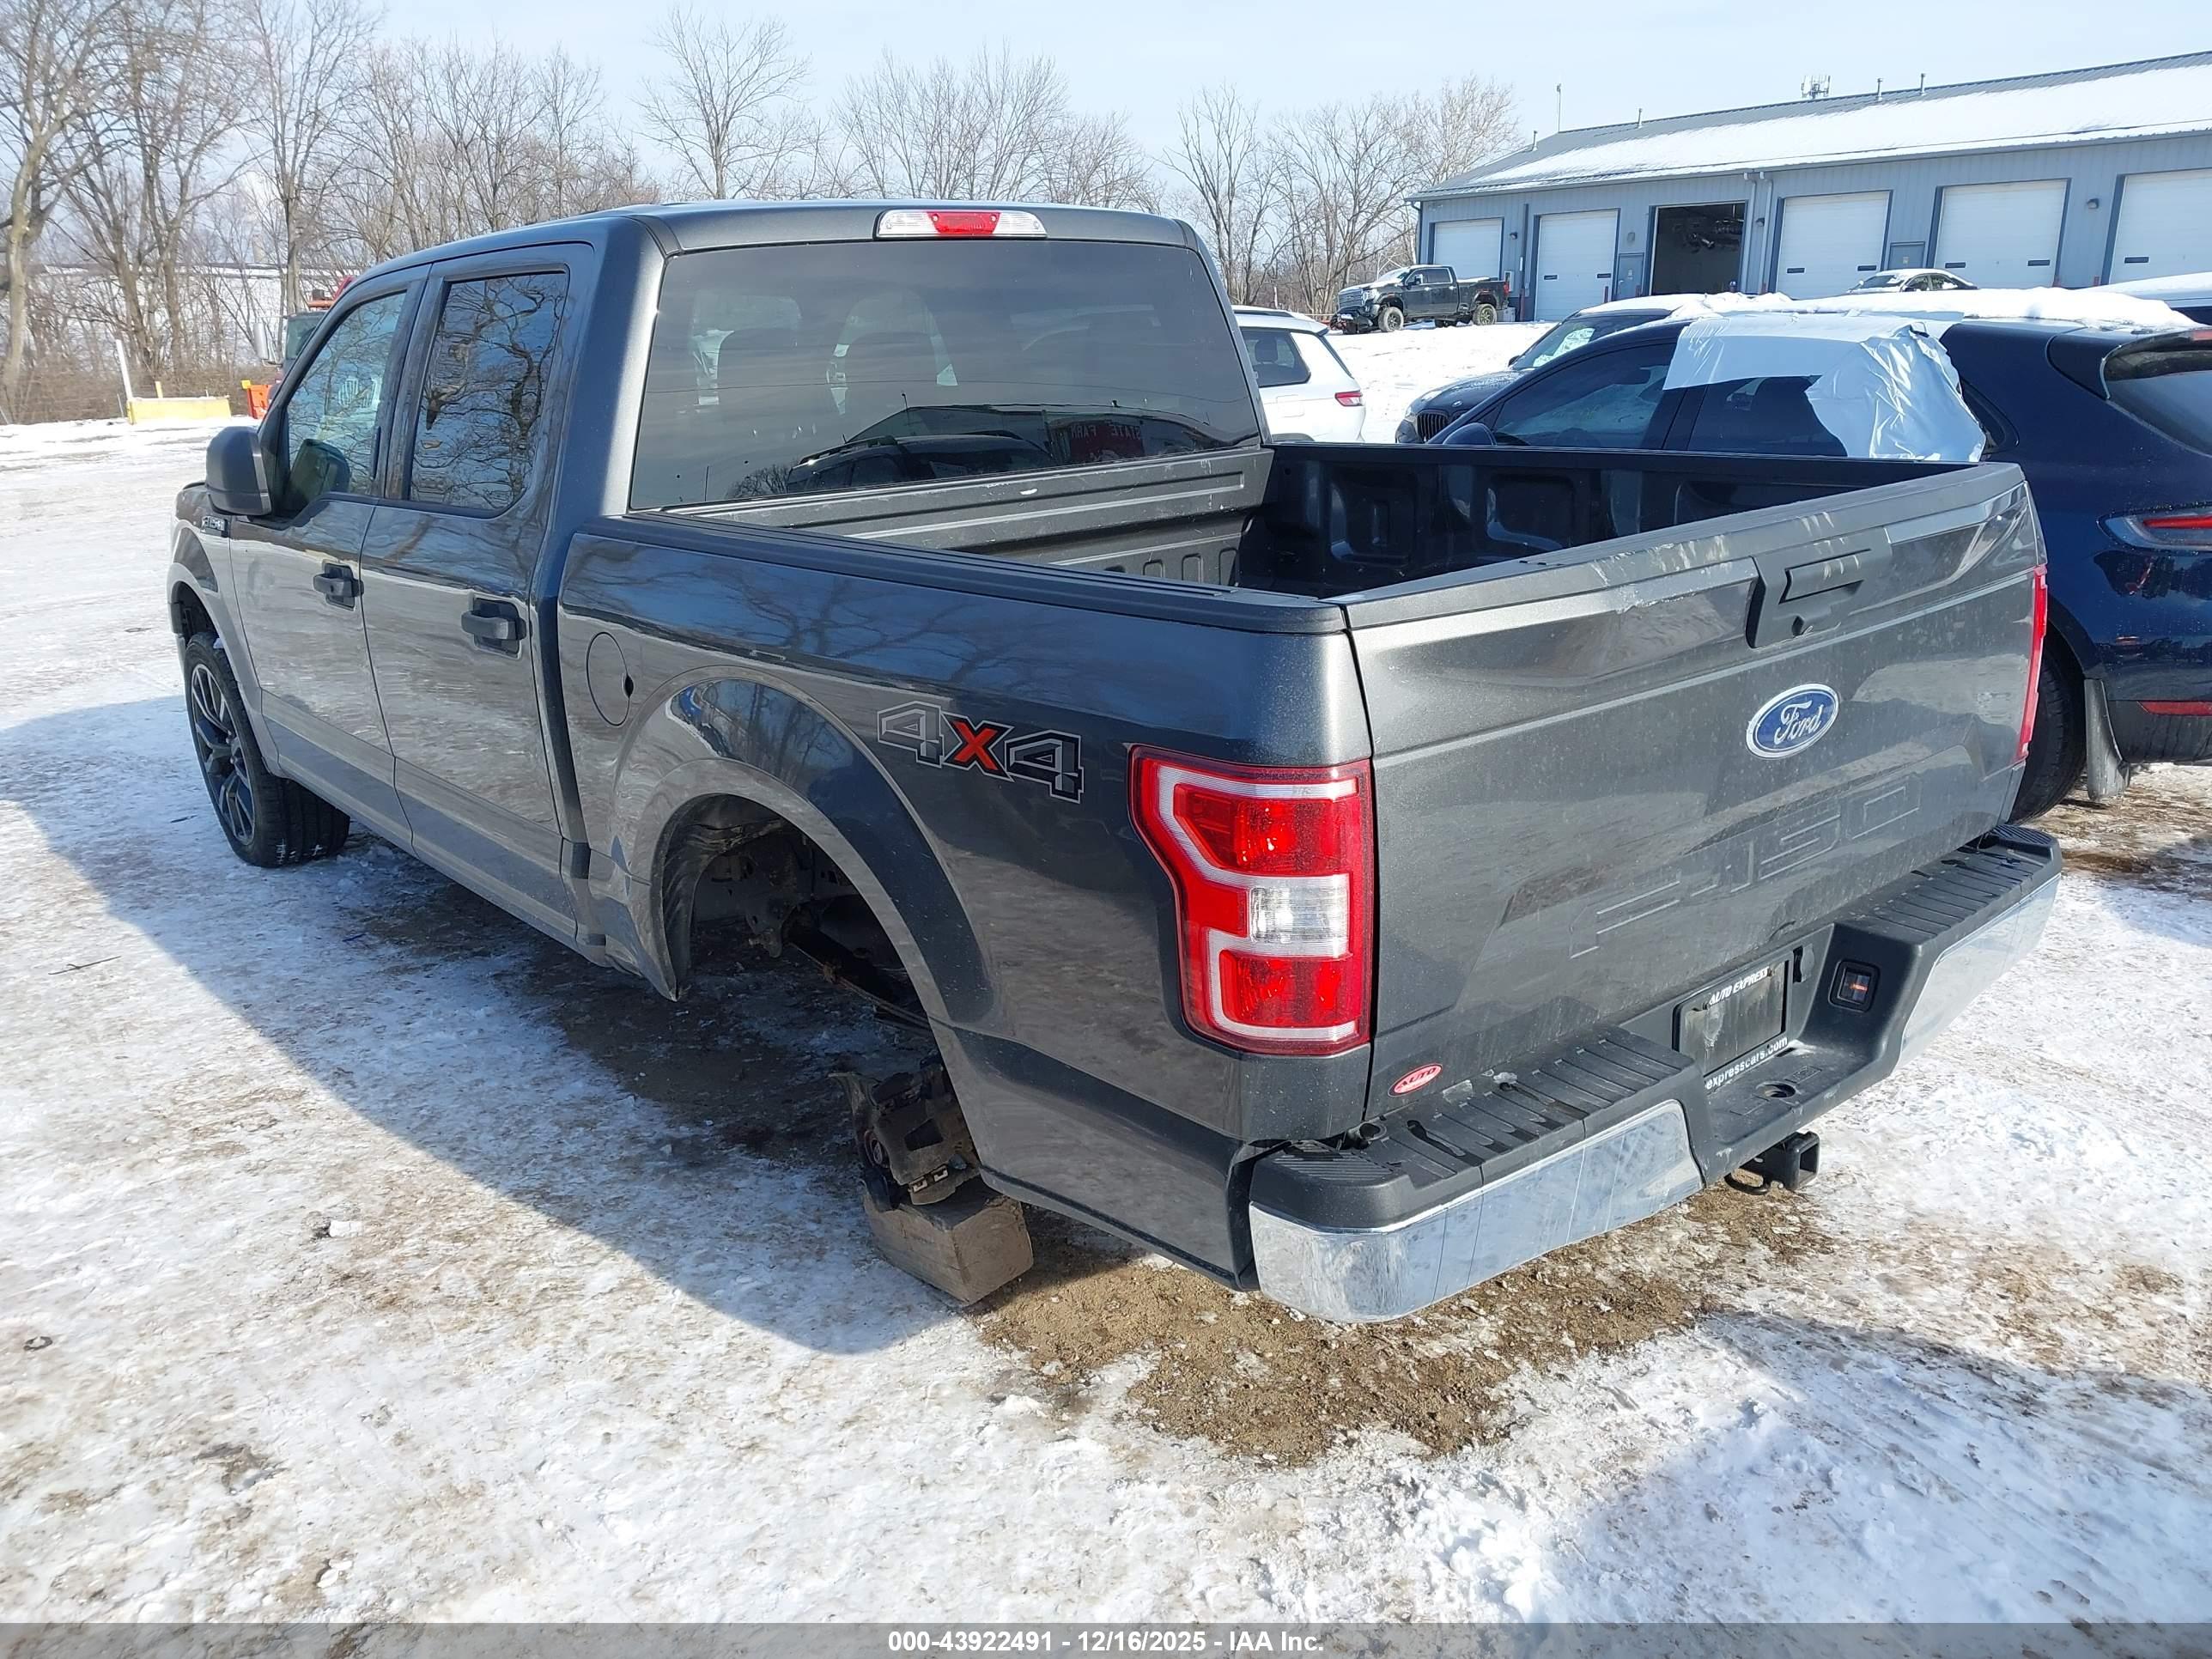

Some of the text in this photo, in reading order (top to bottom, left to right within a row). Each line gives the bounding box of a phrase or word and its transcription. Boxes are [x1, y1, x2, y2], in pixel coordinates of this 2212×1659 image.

[1774, 700, 1824, 745] Ford
[1709, 966, 1770, 1006] AUTO EXPRESS
